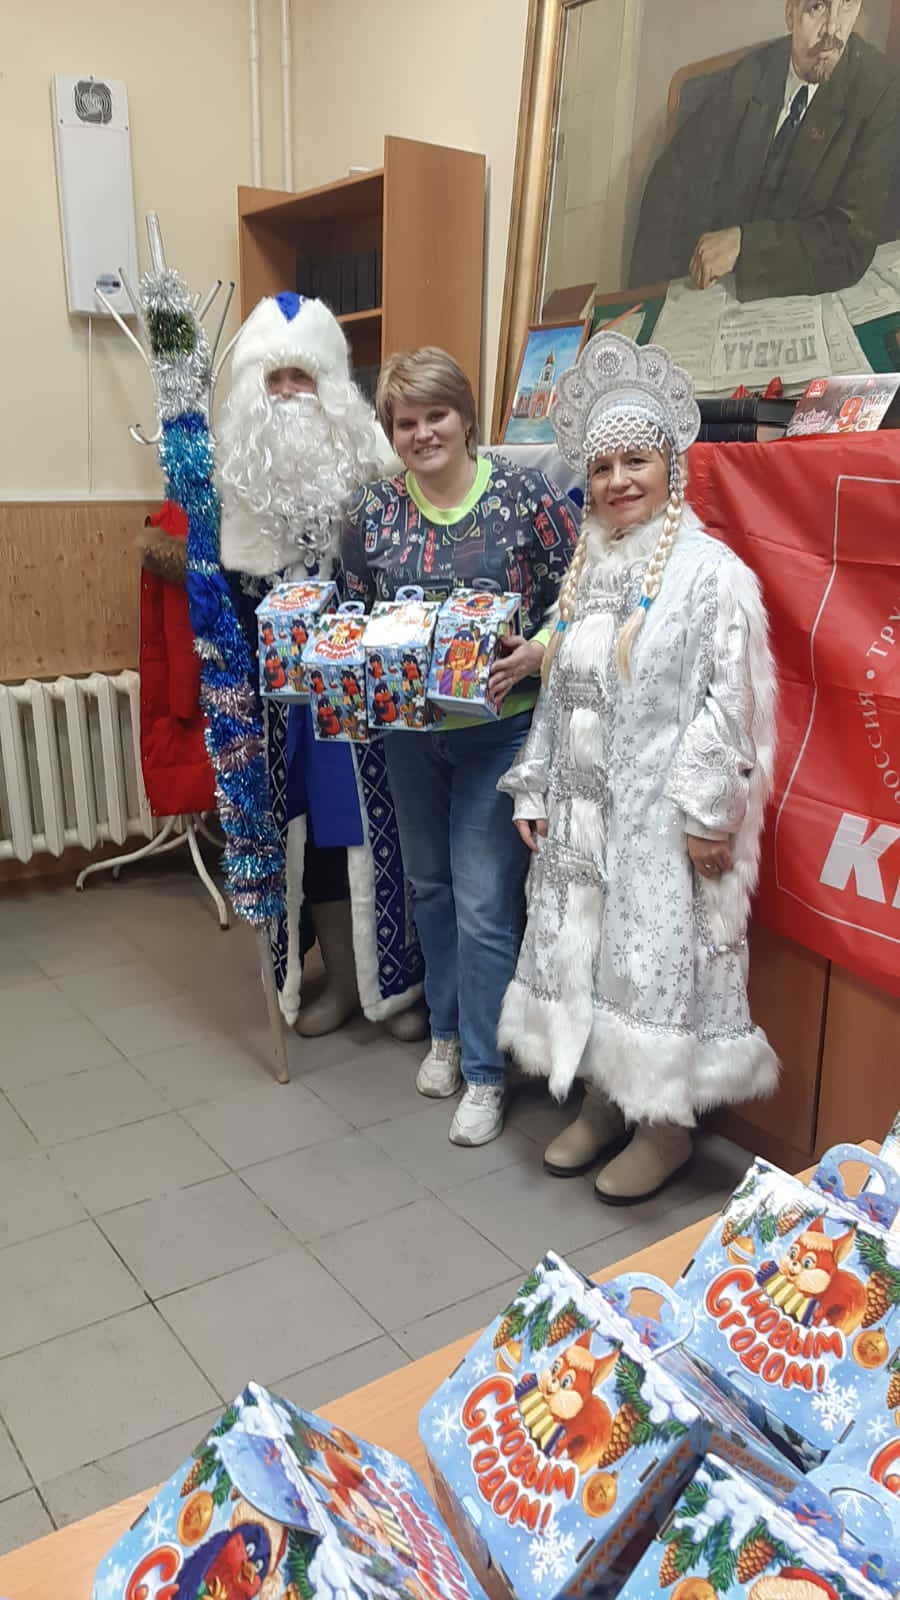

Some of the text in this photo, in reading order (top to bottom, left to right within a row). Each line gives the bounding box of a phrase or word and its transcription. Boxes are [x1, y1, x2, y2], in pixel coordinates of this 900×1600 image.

[836, 395, 864, 430] 9
[857, 691, 900, 806] ОССИЯ
[818, 812, 900, 909] К
[718, 1311, 826, 1392] ГОДОМ!
[741, 1290, 844, 1359] НОВЫМ
[467, 1426, 552, 1537] ГОДОМ!
[494, 1403, 577, 1500] НОВЫМ
